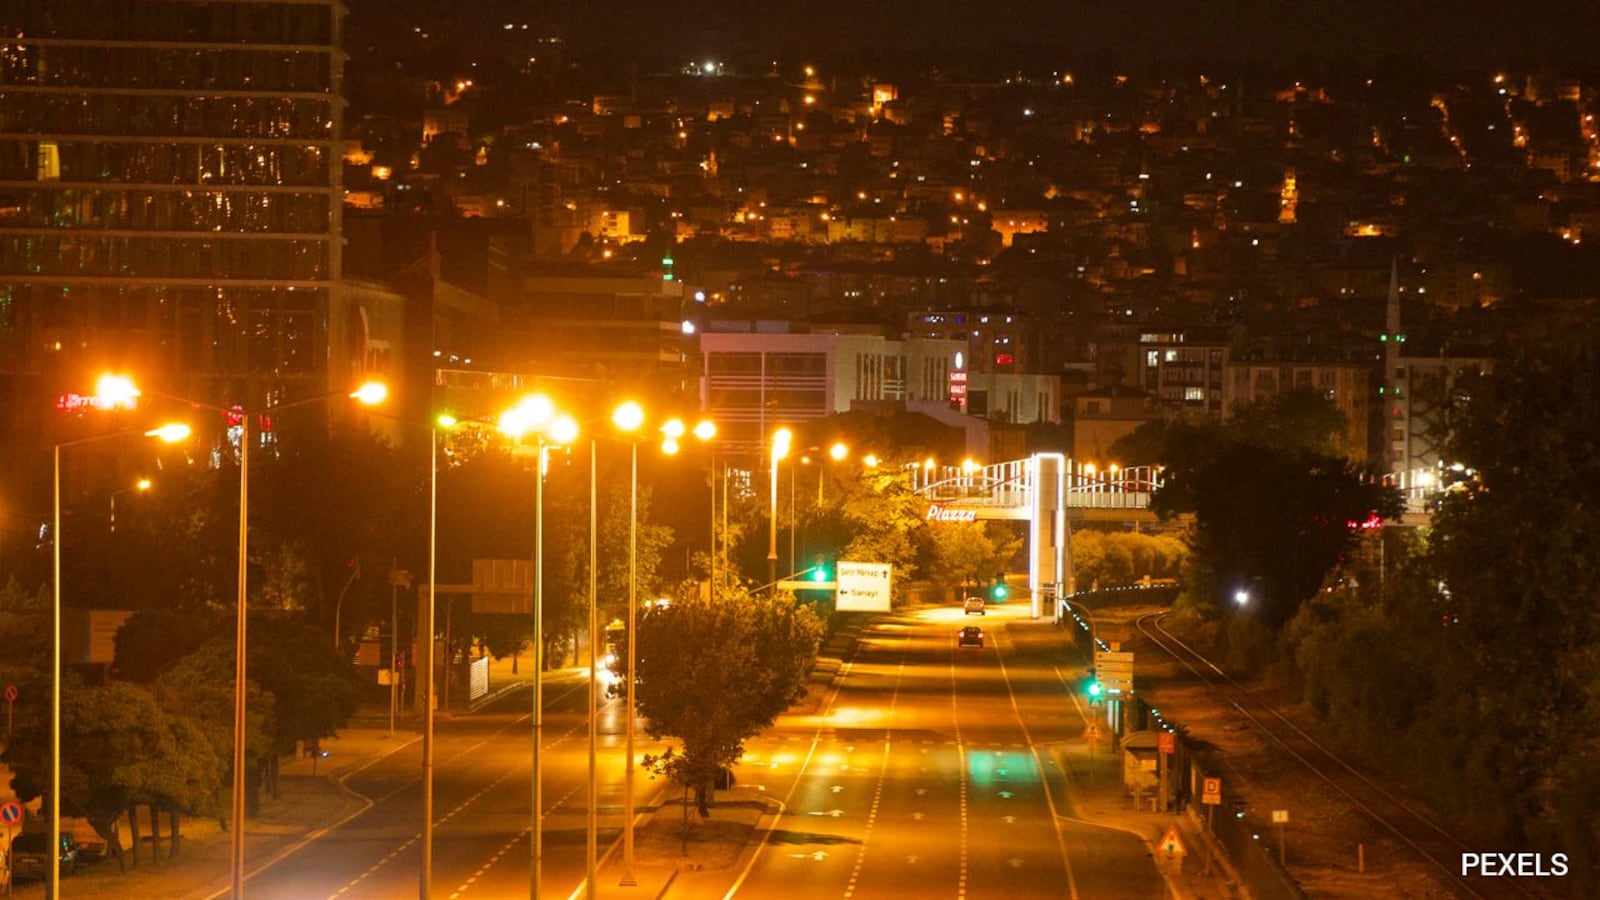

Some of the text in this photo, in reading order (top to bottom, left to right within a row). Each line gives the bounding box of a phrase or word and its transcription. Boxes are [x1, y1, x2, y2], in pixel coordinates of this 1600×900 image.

[926, 505, 977, 522] Piazza
[851, 589, 878, 598] Sanayi
[1208, 781, 1217, 792] D
